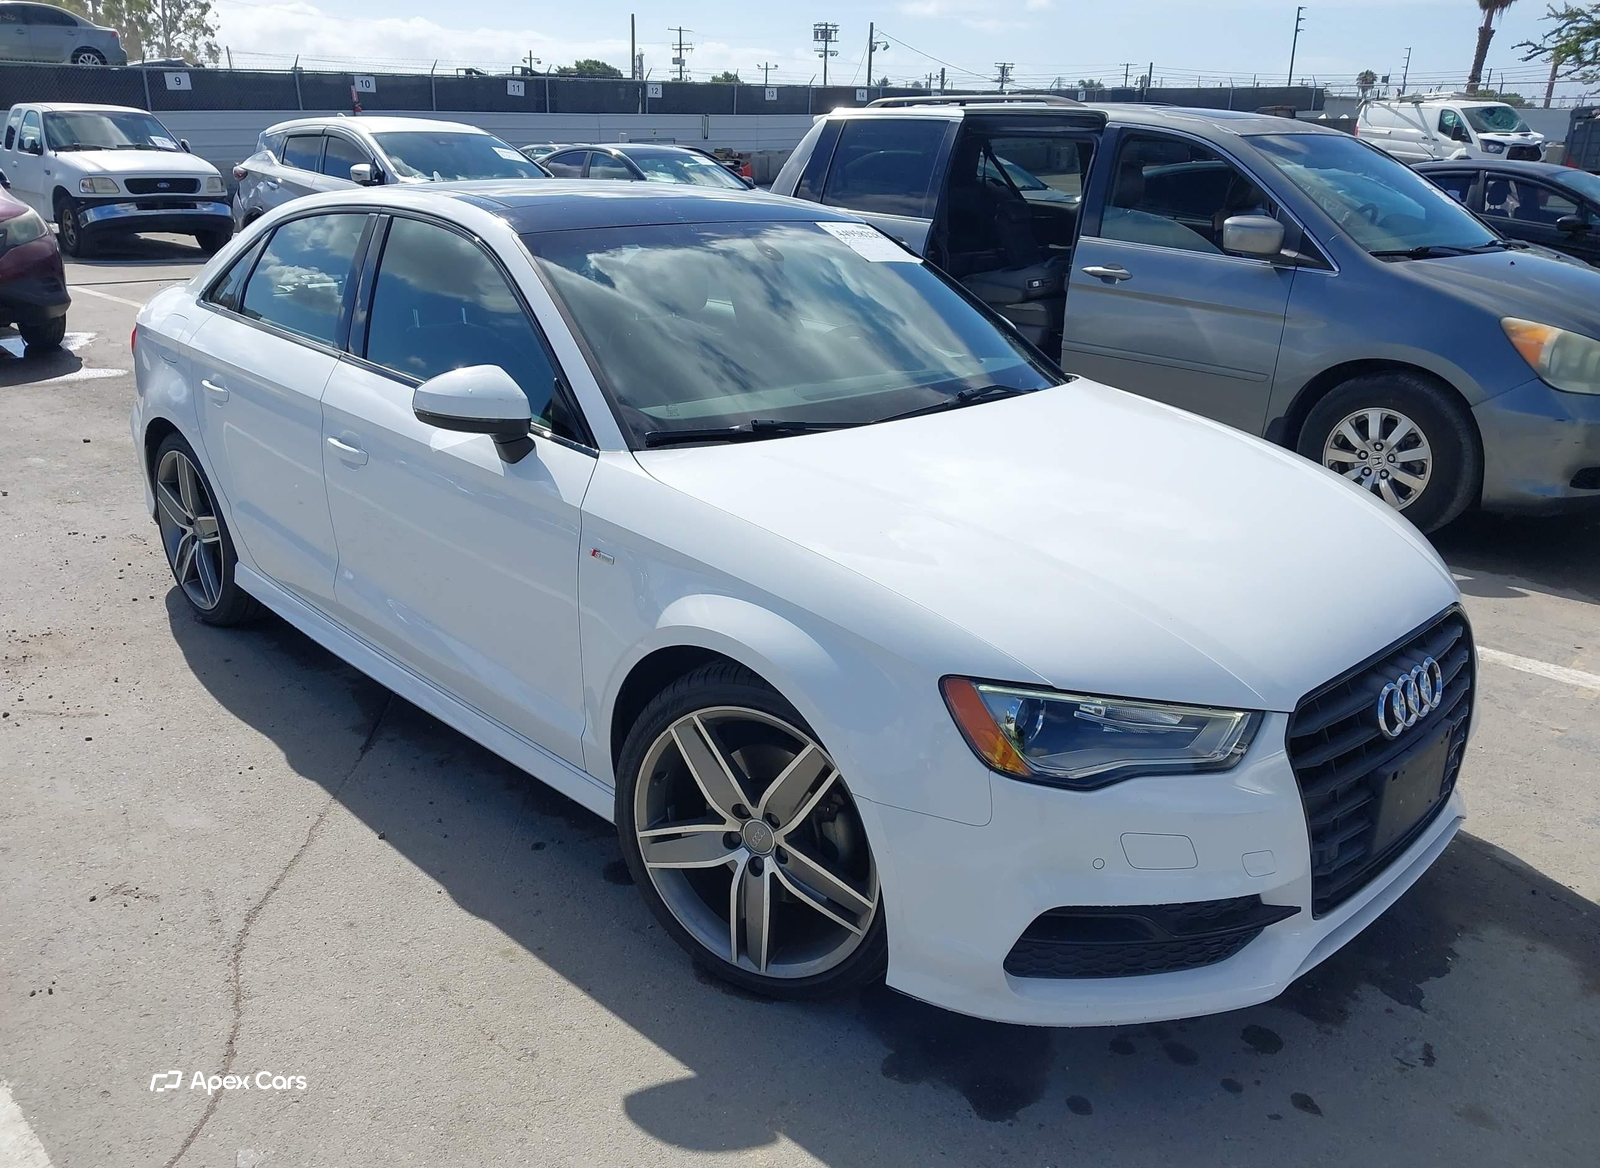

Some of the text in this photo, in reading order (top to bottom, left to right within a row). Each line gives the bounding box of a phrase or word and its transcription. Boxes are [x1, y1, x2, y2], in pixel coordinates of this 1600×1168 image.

[174, 76, 182, 86] 9
[360, 79, 371, 89] 10
[512, 84, 520, 93] 11
[651, 87, 659, 95] 12
[768, 90, 775, 98] 13
